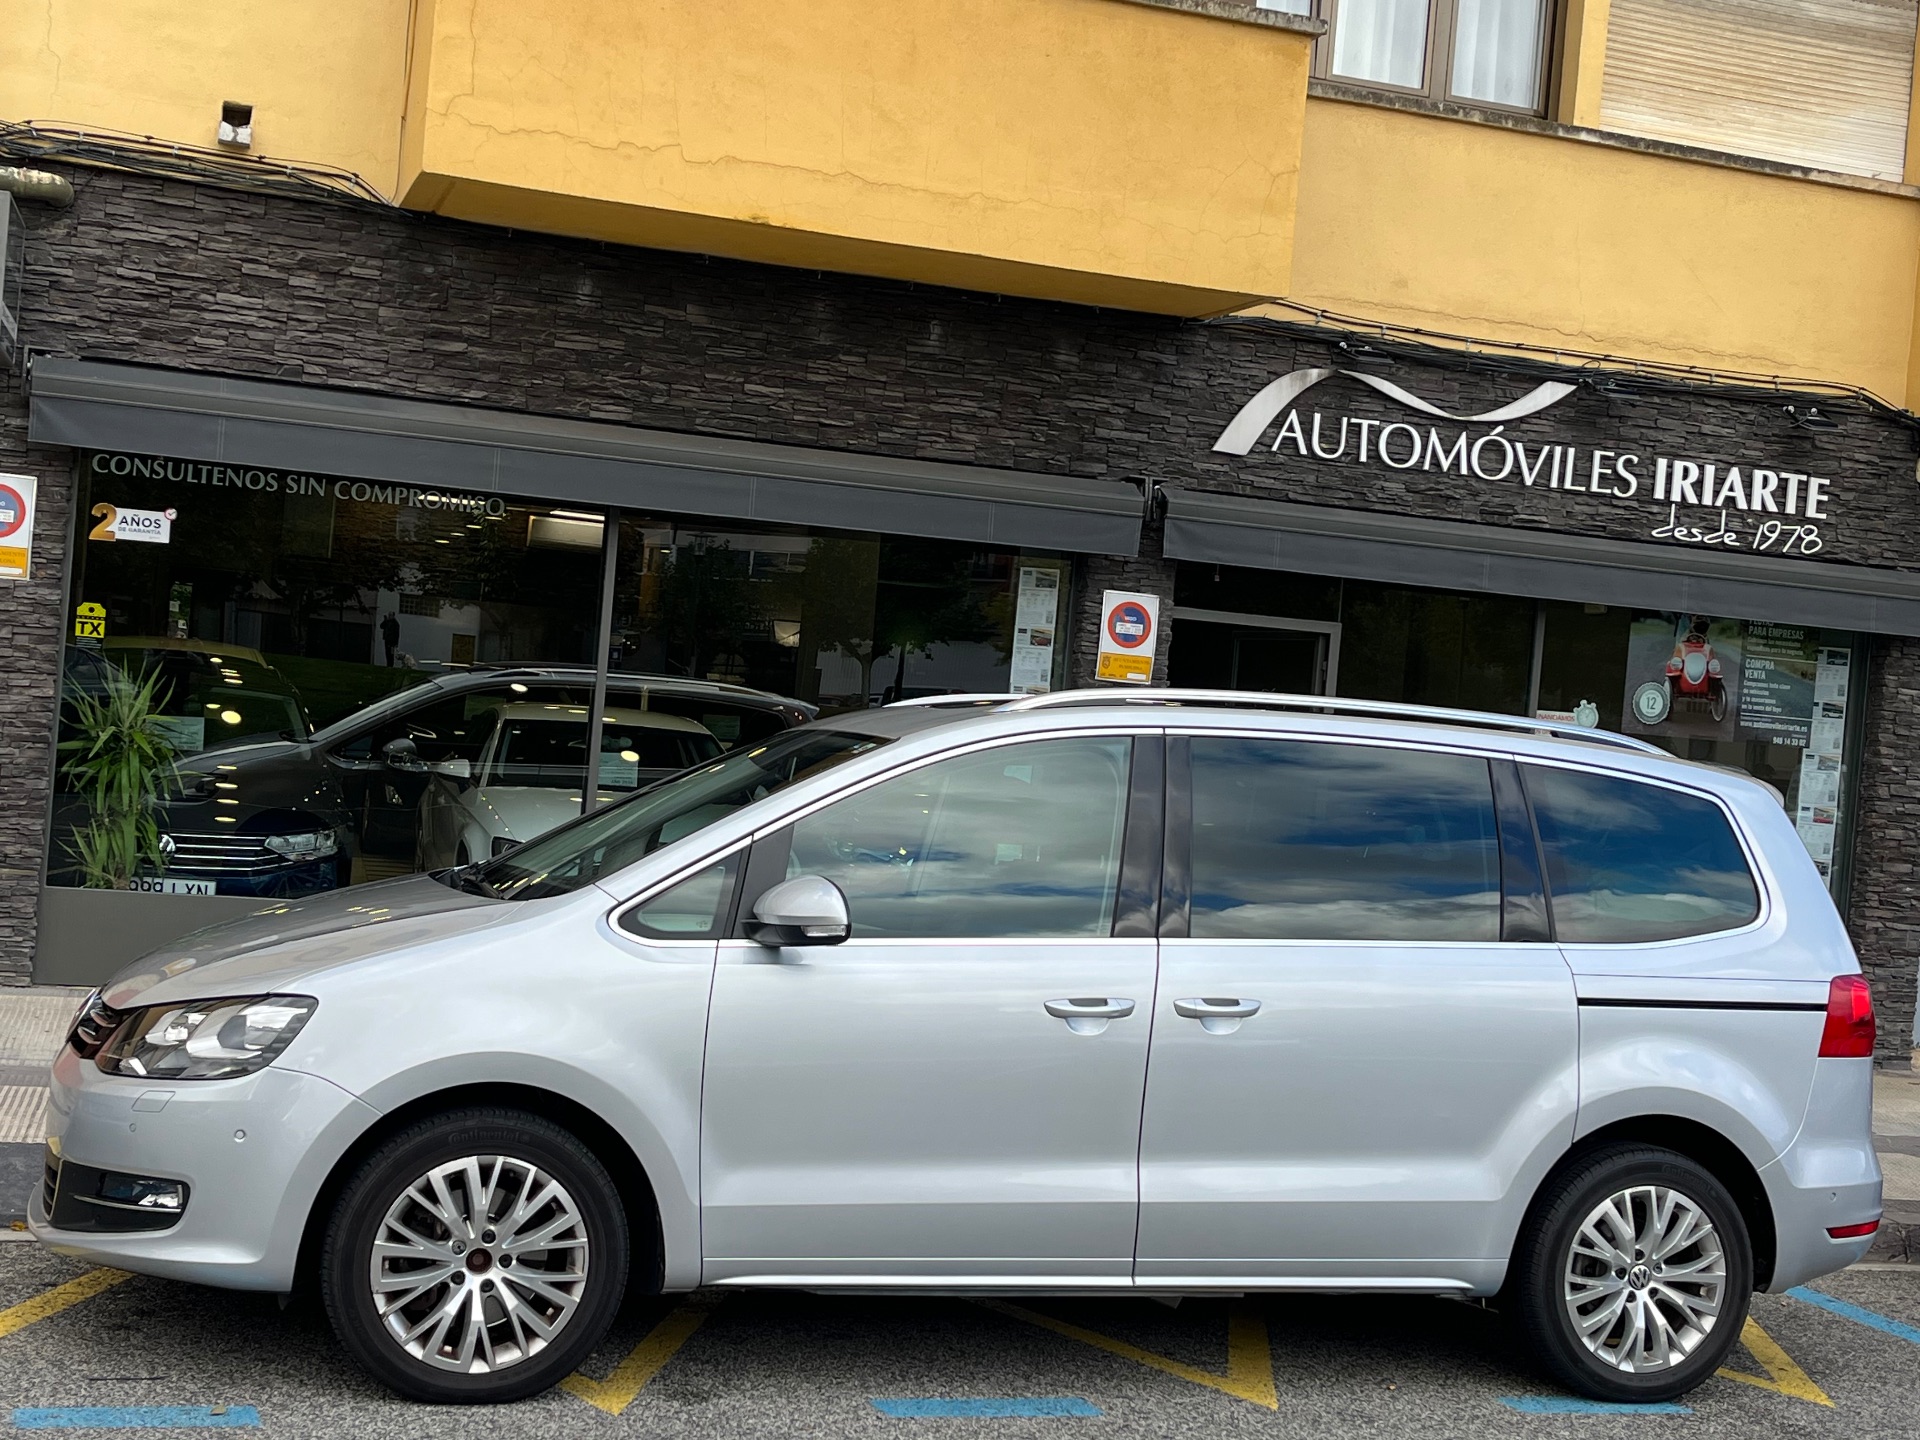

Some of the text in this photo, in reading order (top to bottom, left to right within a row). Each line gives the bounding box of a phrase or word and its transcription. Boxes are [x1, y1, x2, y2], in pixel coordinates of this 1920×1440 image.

[1271, 408, 1831, 520] AUTOMÓVILES IRIARTE
[92, 453, 505, 516] CONSULTENOS SIN COMPROMISO
[89, 502, 162, 542] 2 AÑOS
[1651, 504, 1823, 555] desde 1978
[77, 621, 102, 636] TX
[1748, 626, 1804, 640] PARA EMPRESAS
[1745, 659, 1775, 670] COMPRA
[1744, 669, 1766, 680] VENTA
[1646, 696, 1657, 710] 12
